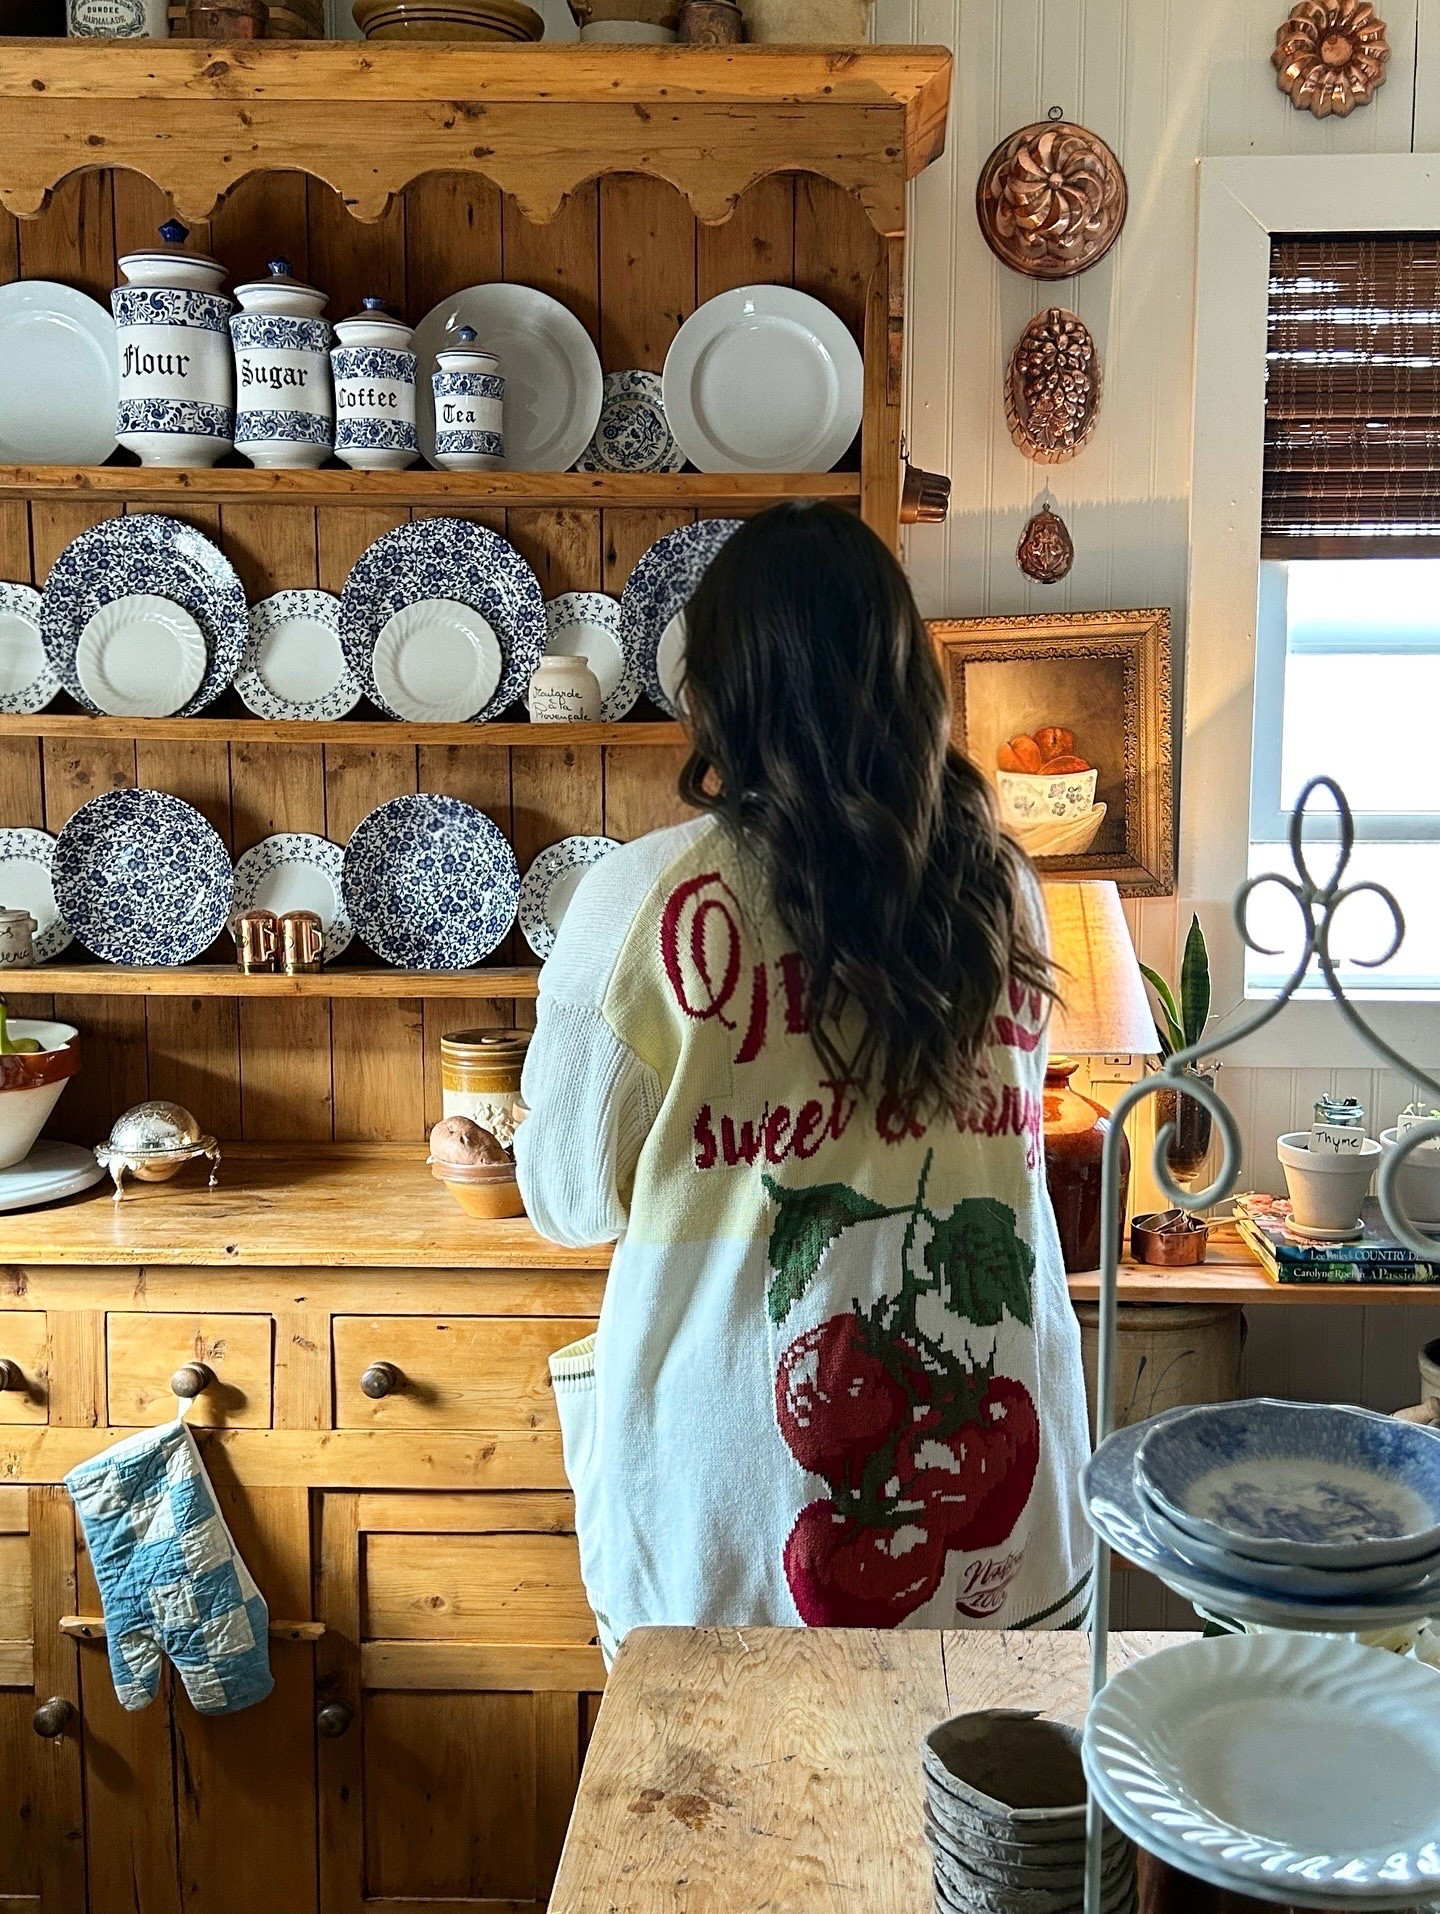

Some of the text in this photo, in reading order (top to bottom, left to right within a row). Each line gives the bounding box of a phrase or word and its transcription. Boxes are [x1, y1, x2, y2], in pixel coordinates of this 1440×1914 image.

[82, 14, 126, 26] MARMALADE
[87, 6, 119, 14] DUNDEE
[122, 343, 190, 378] Flour
[241, 358, 308, 389] Sugar
[338, 387, 398, 409] Coffee
[443, 403, 476, 424] Tea
[694, 1076, 857, 1169] sweet
[1315, 1131, 1360, 1153] Thyme
[1311, 1250, 1325, 1261] Lee
[1354, 1250, 1406, 1261] COUNTRY
[1293, 1267, 1331, 1280] Carolyne
